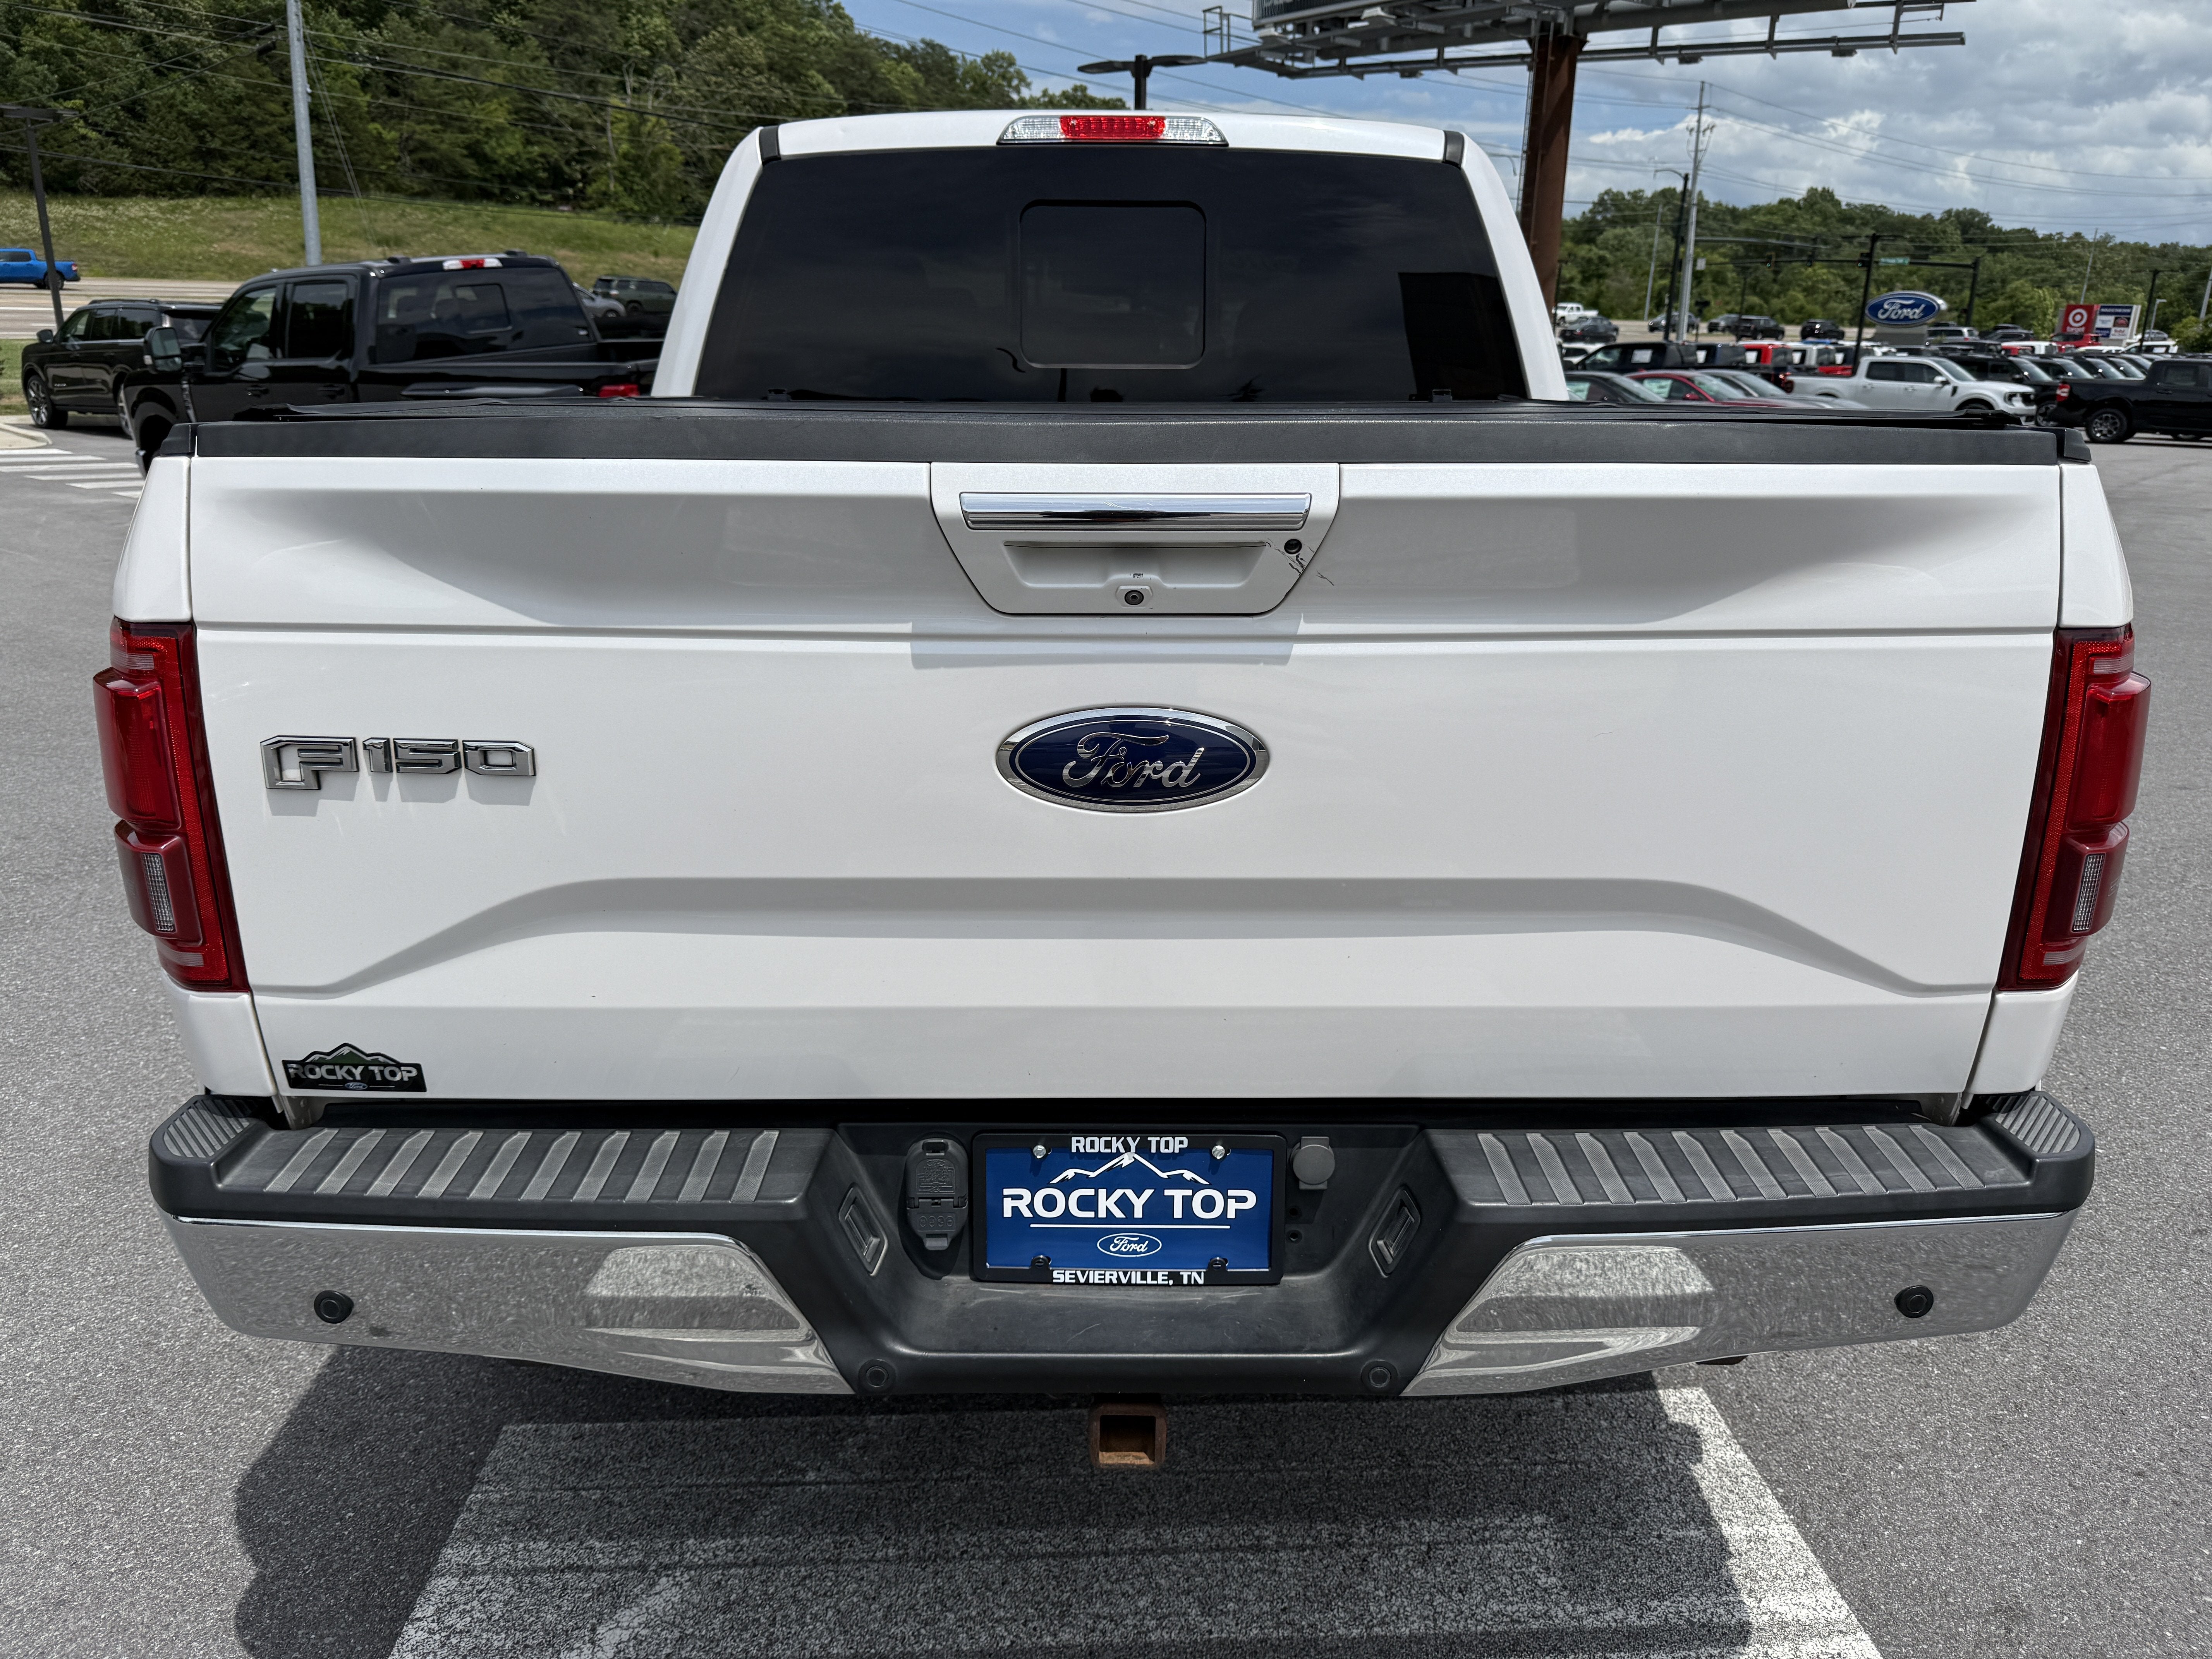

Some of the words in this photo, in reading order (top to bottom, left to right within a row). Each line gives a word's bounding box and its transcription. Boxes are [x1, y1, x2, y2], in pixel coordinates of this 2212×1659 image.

[1877, 299, 1926, 319] Ford
[1062, 732, 1205, 788] Ford
[287, 1063, 365, 1080] ROCKY
[368, 1066, 417, 1081] TOP
[1071, 1137, 1140, 1153] ROCKY
[1147, 1137, 1188, 1154] TOP
[1003, 1188, 1155, 1218] ROCKY
[1164, 1189, 1257, 1219] TOP
[1109, 1236, 1149, 1252] Ford
[1053, 1270, 1173, 1286] SEVIERVILLE,
[1180, 1271, 1204, 1285] TN
